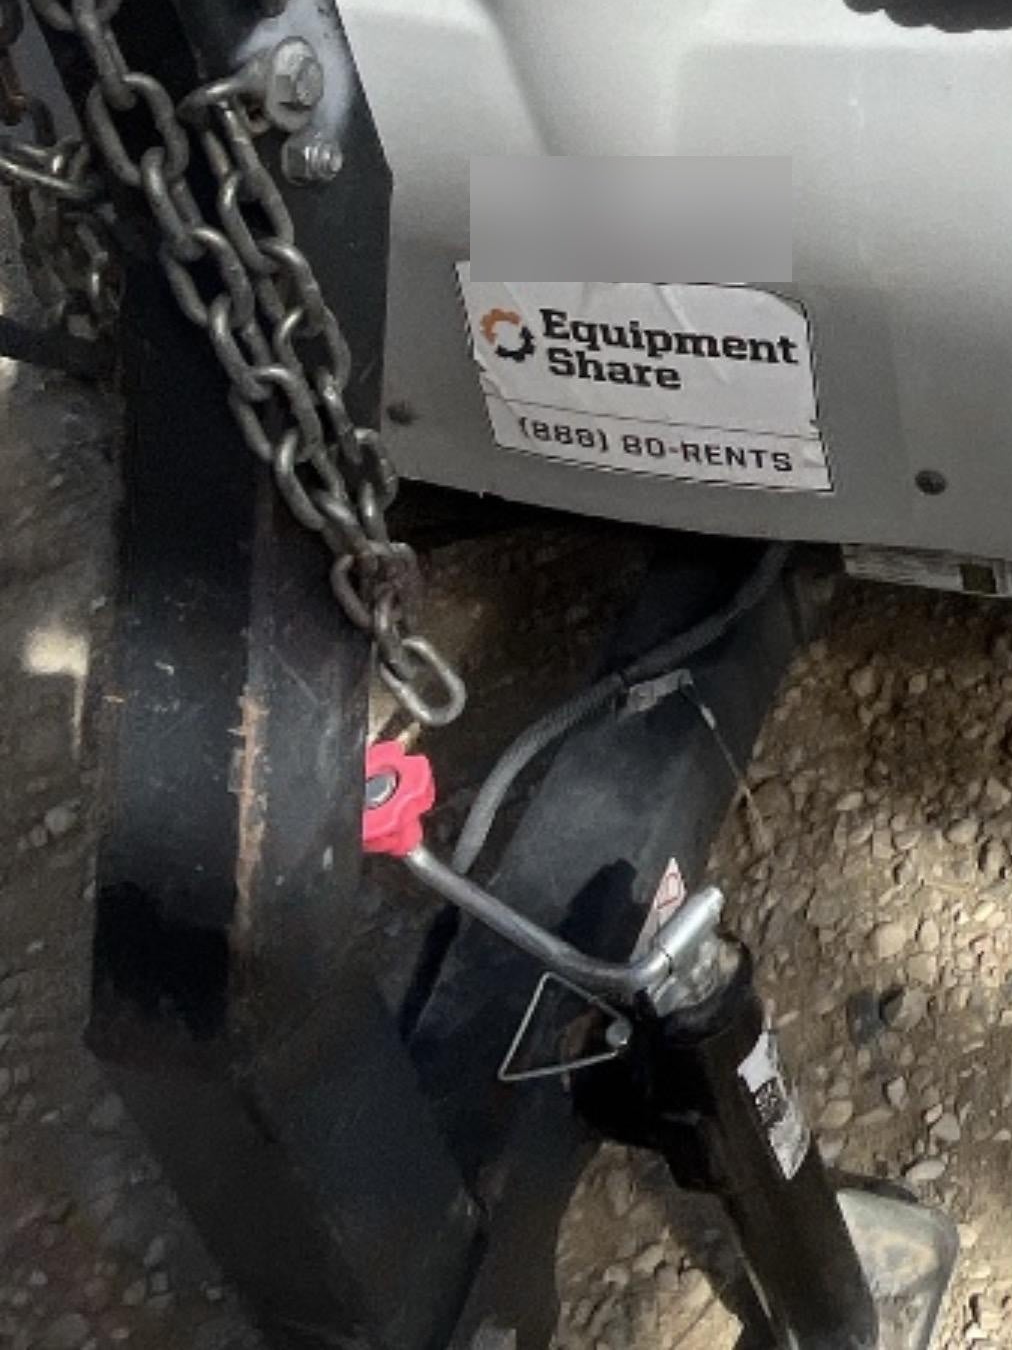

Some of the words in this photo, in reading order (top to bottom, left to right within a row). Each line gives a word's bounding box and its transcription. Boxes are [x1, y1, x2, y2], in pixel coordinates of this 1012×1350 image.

[540, 308, 799, 365] Equipment
[548, 347, 682, 390] Share
[518, 416, 608, 452] (888)
